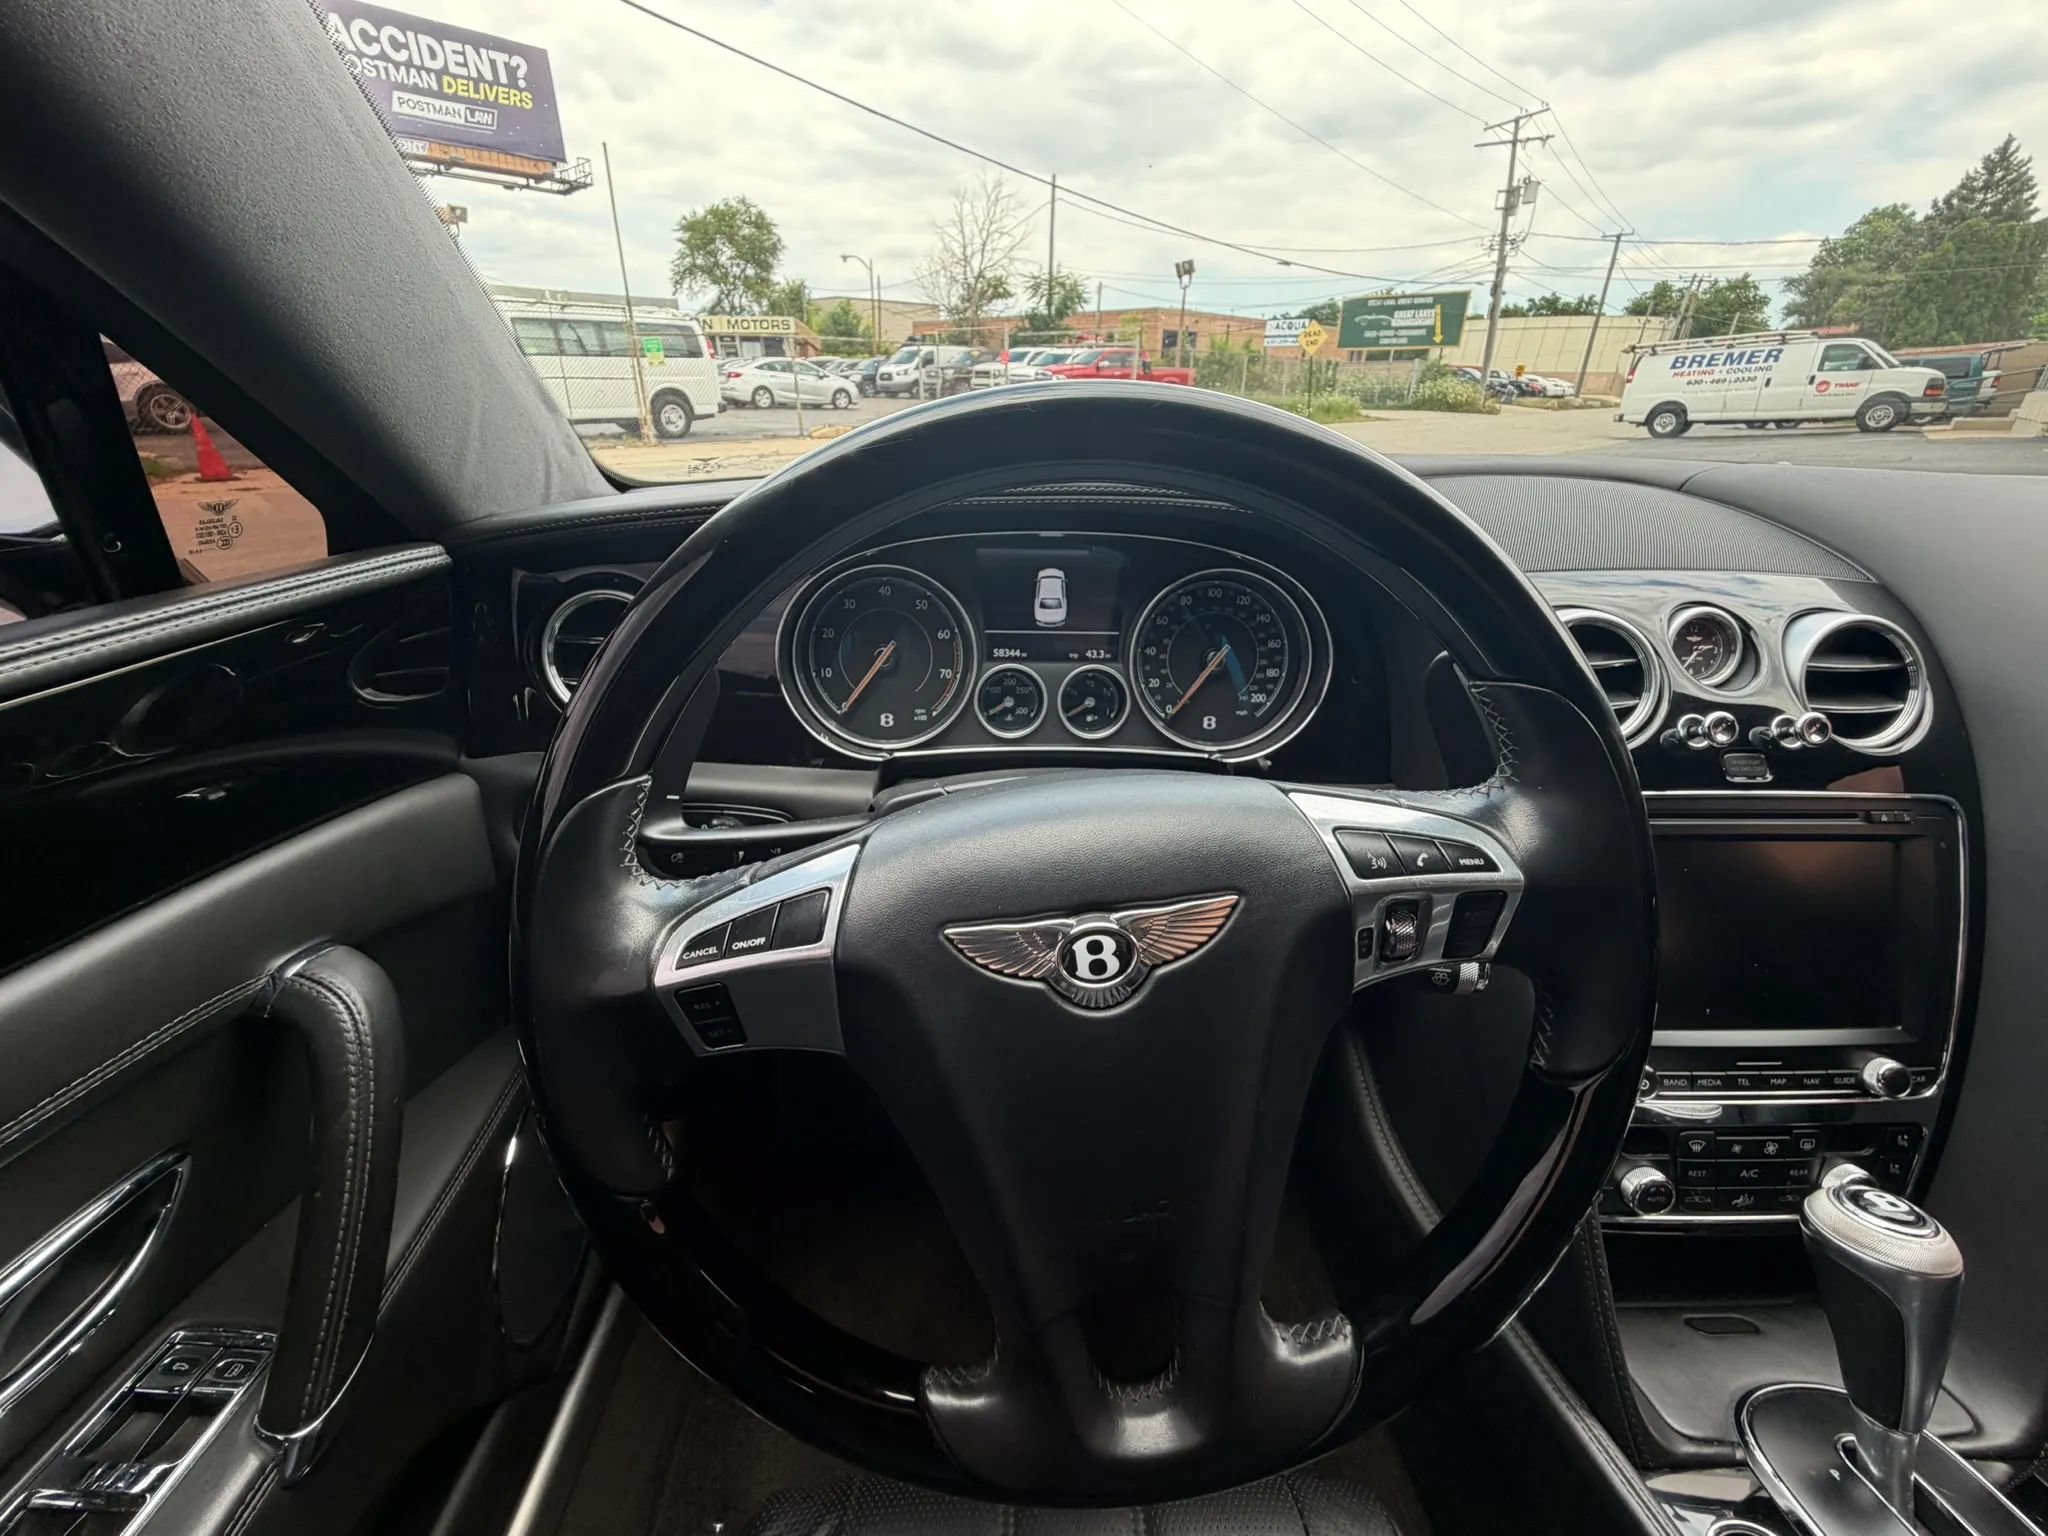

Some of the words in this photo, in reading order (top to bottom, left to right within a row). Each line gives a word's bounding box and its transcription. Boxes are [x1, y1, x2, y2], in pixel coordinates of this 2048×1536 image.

[327, 12, 528, 88] ACCIDENT?
[345, 53, 438, 91] OSTMAN
[442, 75, 533, 110] DELIVERS
[396, 96, 463, 121] POSTMAN
[466, 107, 494, 125] LAW
[726, 318, 792, 330] MOTORS
[1275, 320, 1307, 330] ACQUA
[1303, 329, 1322, 338] DEAD
[1670, 348, 1784, 370] BREMER
[1672, 368, 1715, 378] HEATING
[1726, 364, 1773, 375] COOLING
[878, 585, 891, 596] 40
[1207, 588, 1222, 598] 100
[843, 599, 856, 609] 30
[915, 599, 928, 610] 50
[1180, 595, 1192, 605] 80
[1236, 595, 1250, 605] 120
[1156, 616, 1168, 625] 60
[1256, 614, 1270, 623] 140
[821, 628, 835, 638] 20
[937, 629, 950, 640] 60
[1267, 639, 1281, 649] 160
[993, 648, 1020, 658] 58344
[1085, 650, 1104, 659] 43.3
[1144, 646, 1156, 656] 40
[820, 667, 832, 678] 10
[939, 668, 952, 679] 70
[1265, 668, 1280, 678] 180
[1149, 678, 1160, 688] 20
[1250, 693, 1267, 703] 200
[1166, 704, 1173, 714] 0
[1459, 857, 1485, 866] MENU
[731, 937, 766, 951] ON/OFF
[682, 946, 718, 960] CANCEL
[1071, 934, 1121, 980] B
[1663, 1078, 1687, 1087] BAND
[1697, 1078, 1722, 1087] MEDIA
[1738, 1078, 1750, 1087] TEL
[1770, 1077, 1787, 1086] MAP
[1803, 1077, 1820, 1086] NAV
[1833, 1077, 1856, 1086] GUIDE
[1911, 1075, 1926, 1083] CAR
[1688, 1169, 1706, 1177] REST
[1739, 1169, 1760, 1178] A/C
[1829, 1469, 1840, 1480] P
